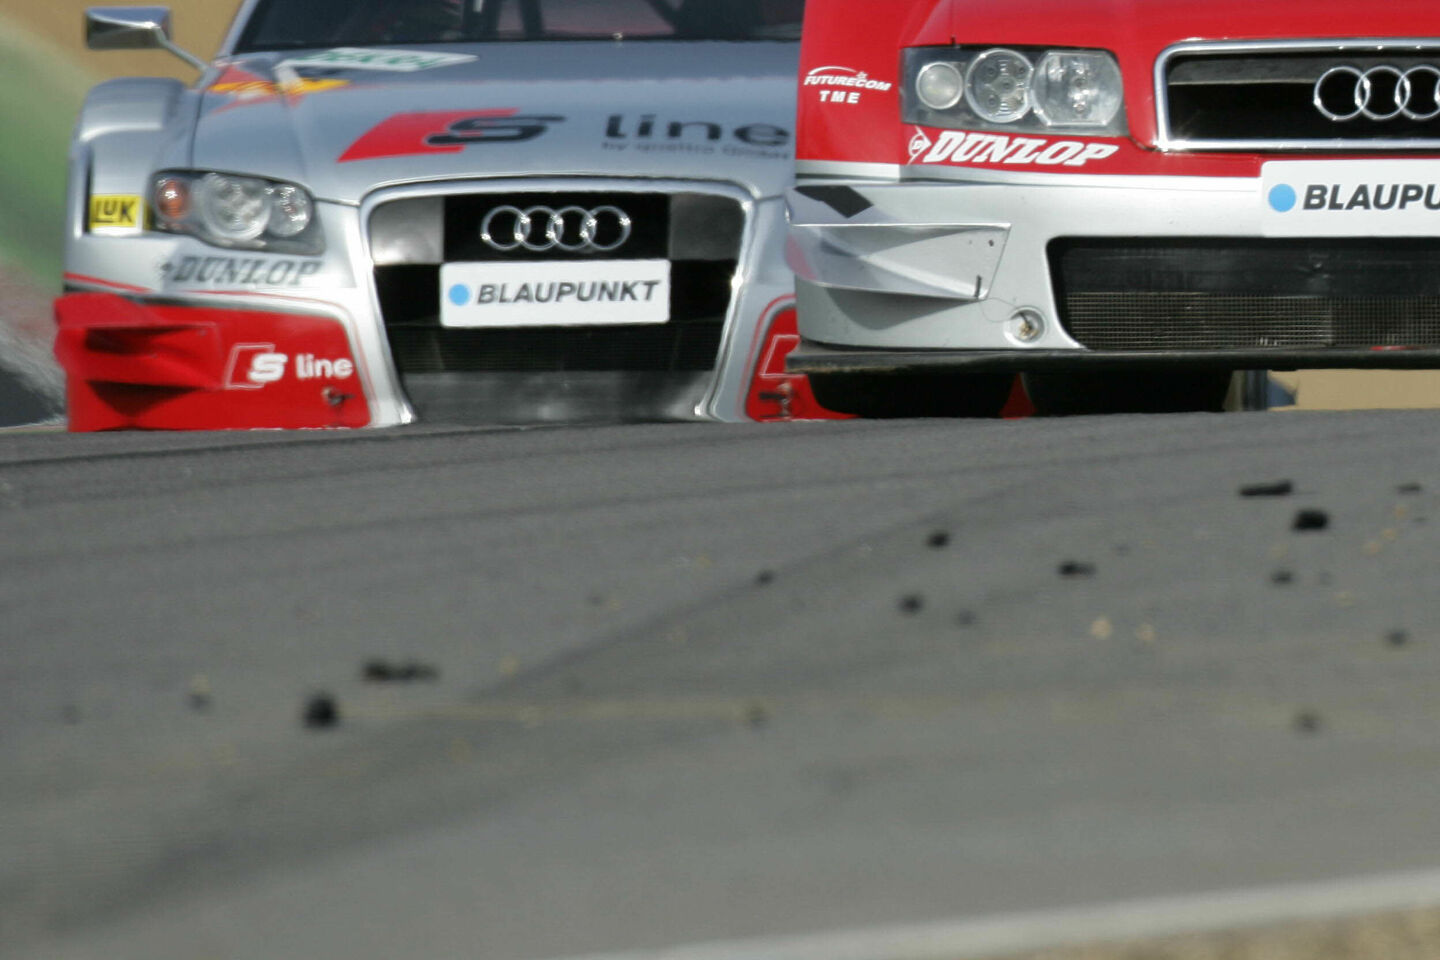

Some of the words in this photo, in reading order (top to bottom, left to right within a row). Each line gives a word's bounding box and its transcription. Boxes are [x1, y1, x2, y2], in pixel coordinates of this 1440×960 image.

[803, 75, 892, 91] FUTURECOM
[819, 90, 860, 104] TME
[605, 113, 791, 146] line
[922, 130, 1120, 166] DUNLOP
[172, 256, 322, 285] DUNLOP
[477, 279, 661, 305] BLAUPUNKT
[247, 352, 288, 382] S
[296, 353, 353, 379] line
